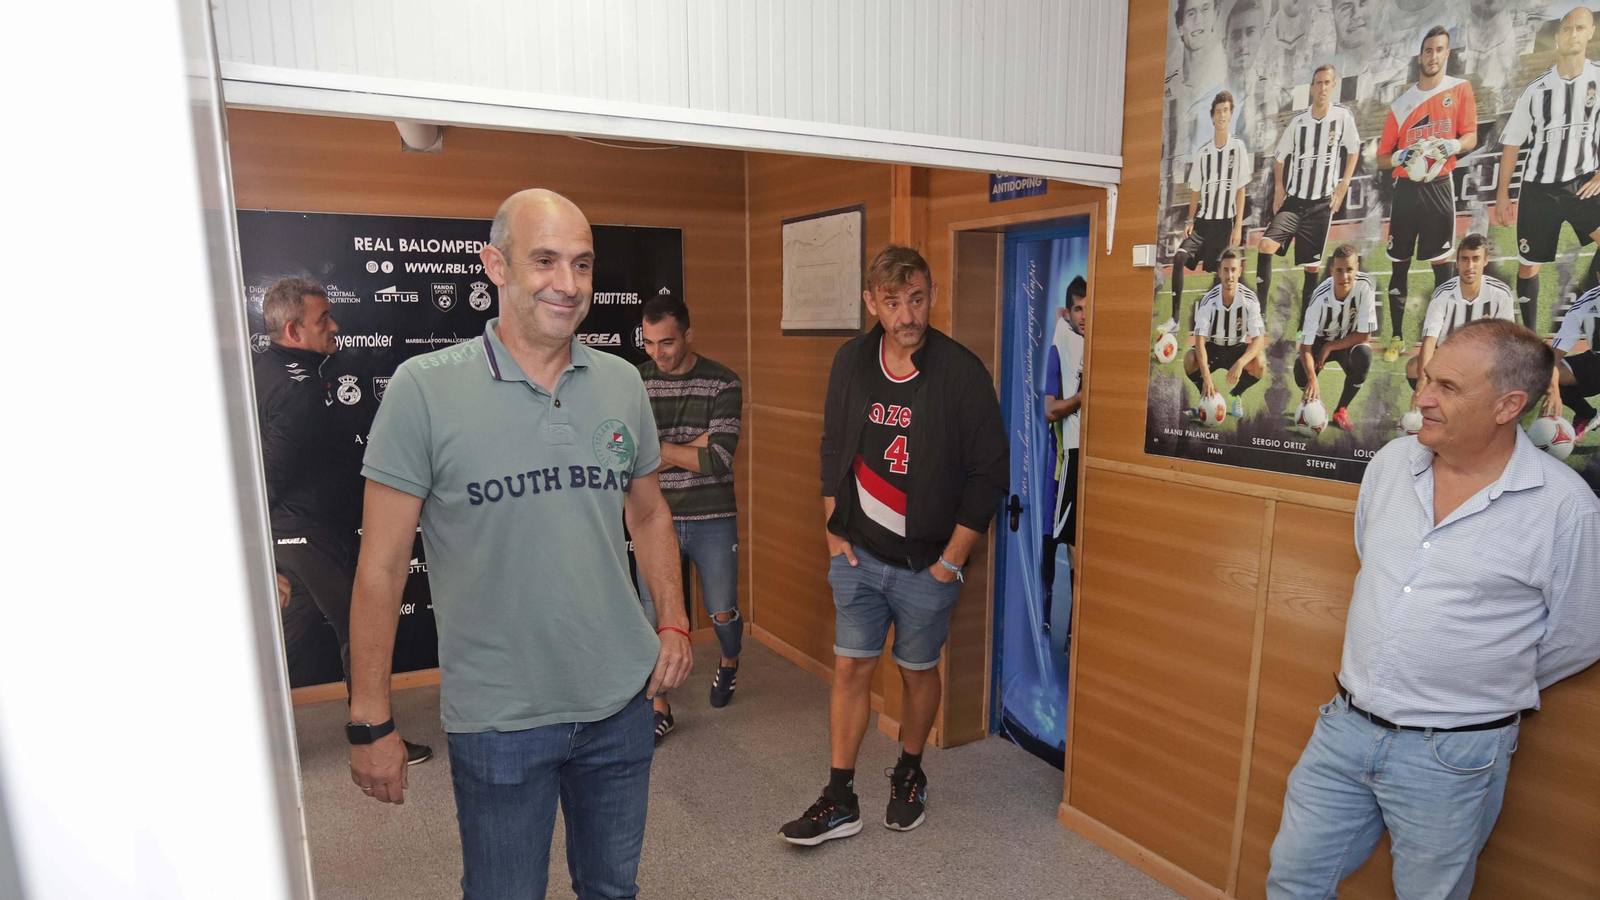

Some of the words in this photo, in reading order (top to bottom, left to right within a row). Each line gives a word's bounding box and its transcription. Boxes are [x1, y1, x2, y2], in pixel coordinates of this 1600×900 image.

[992, 178, 1042, 195] ANTIDOPING
[354, 237, 395, 252] REAL
[374, 293, 419, 303] LOTUS
[593, 292, 642, 305] FOOTTERS.
[1163, 427, 1184, 437] MANU
[1184, 429, 1219, 441] PALANCAR
[1252, 437, 1281, 449] SERGIO
[1283, 440, 1307, 451] ORTIZ
[883, 435, 909, 475] 4
[1206, 446, 1224, 456] IVAN
[1353, 449, 1376, 459] LOLO
[1306, 459, 1337, 471] STEVEN
[467, 466, 562, 506] SOUTH
[277, 537, 308, 545] LEGEA
